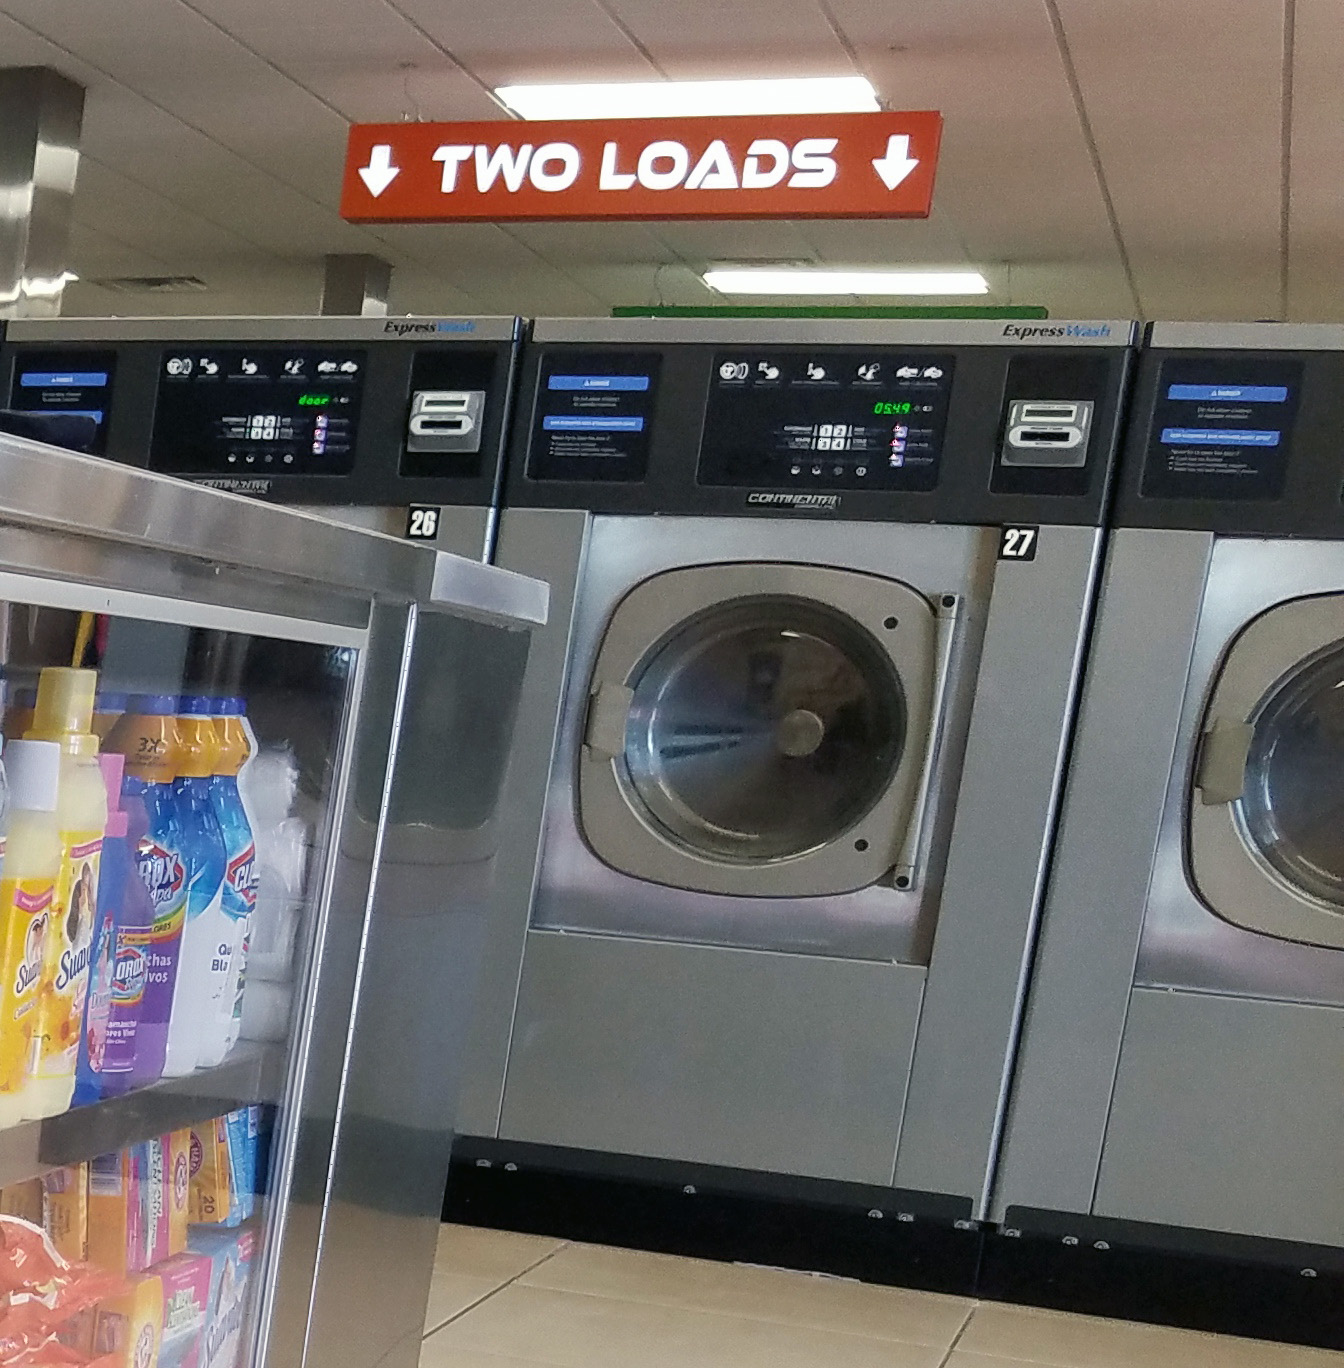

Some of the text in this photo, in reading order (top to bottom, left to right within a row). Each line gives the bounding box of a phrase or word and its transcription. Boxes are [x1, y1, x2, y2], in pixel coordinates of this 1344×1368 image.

[432, 137, 840, 193] TWO LOADS
[1002, 323, 1111, 340] ExpressWash
[409, 510, 437, 536] 26
[1002, 528, 1035, 556] 27
